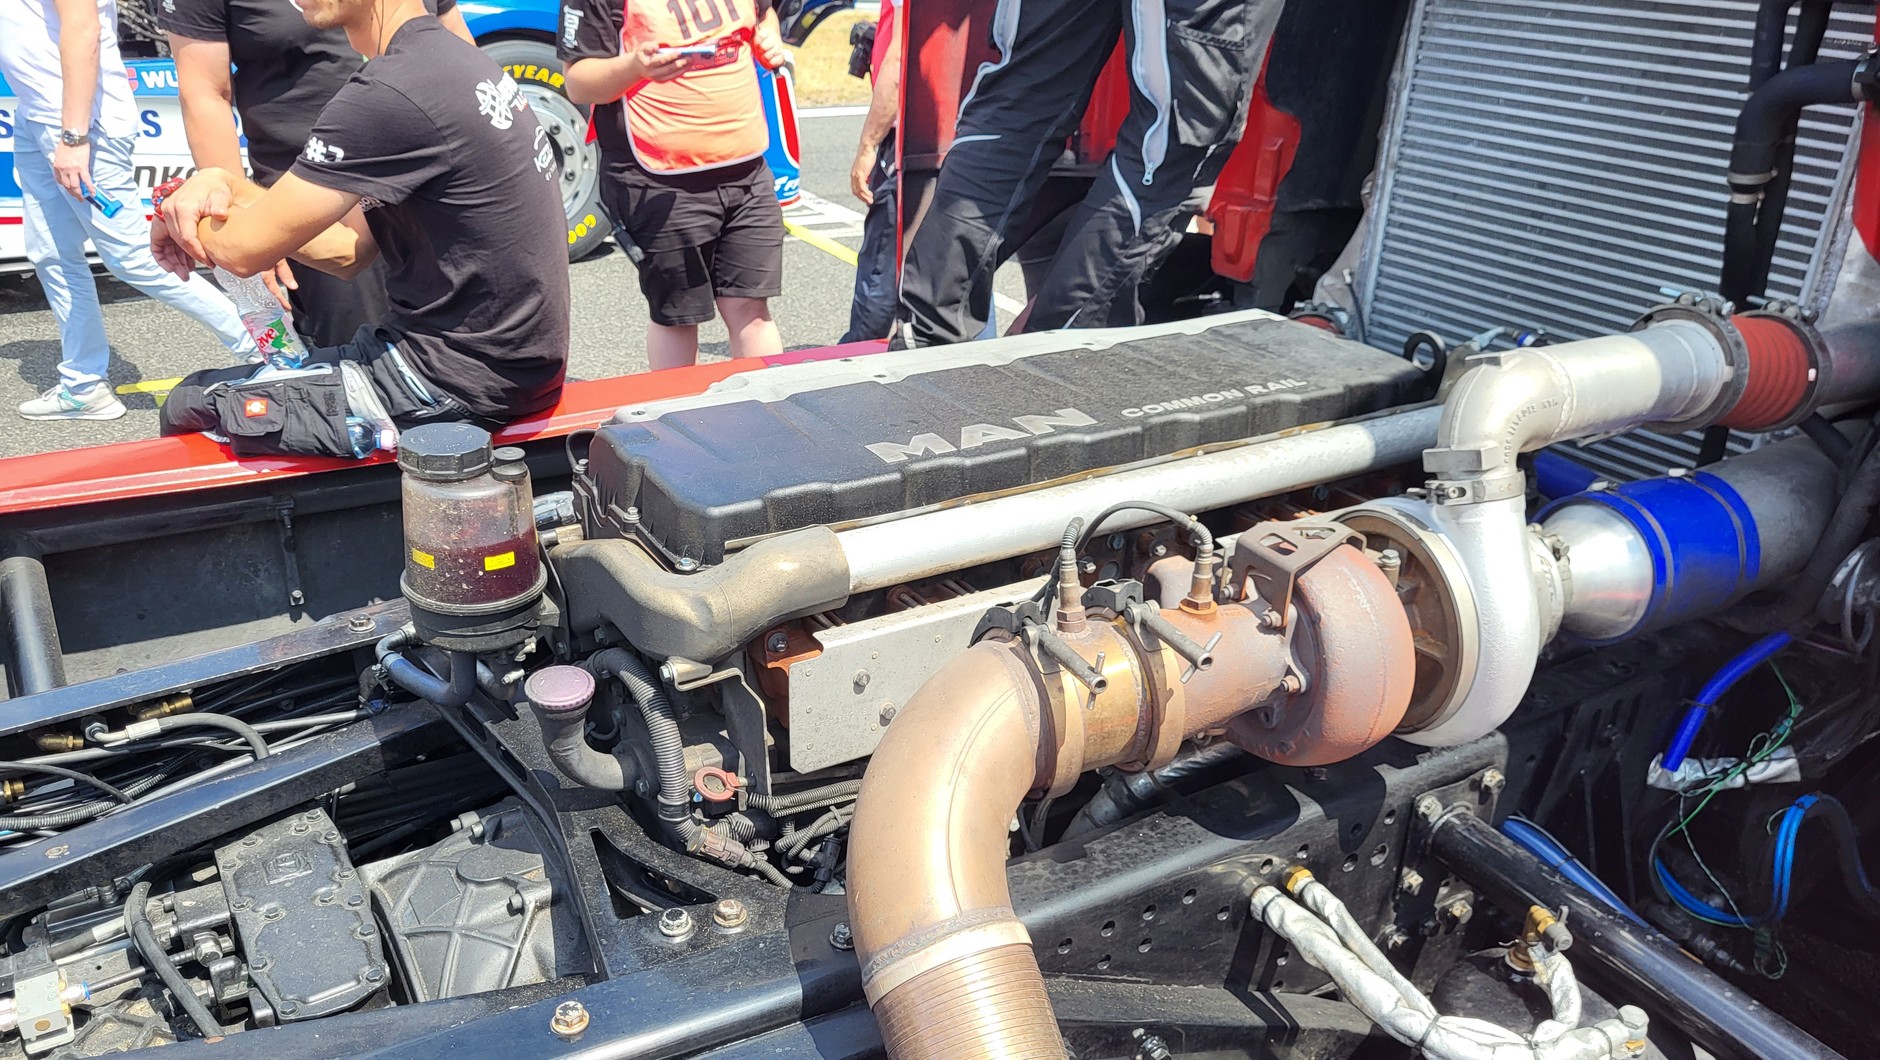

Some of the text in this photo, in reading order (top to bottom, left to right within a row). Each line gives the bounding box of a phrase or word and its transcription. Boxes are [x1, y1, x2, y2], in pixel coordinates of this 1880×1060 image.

[1121, 378, 1307, 417] COMMON RAIL
[864, 407, 1098, 463] MAN
